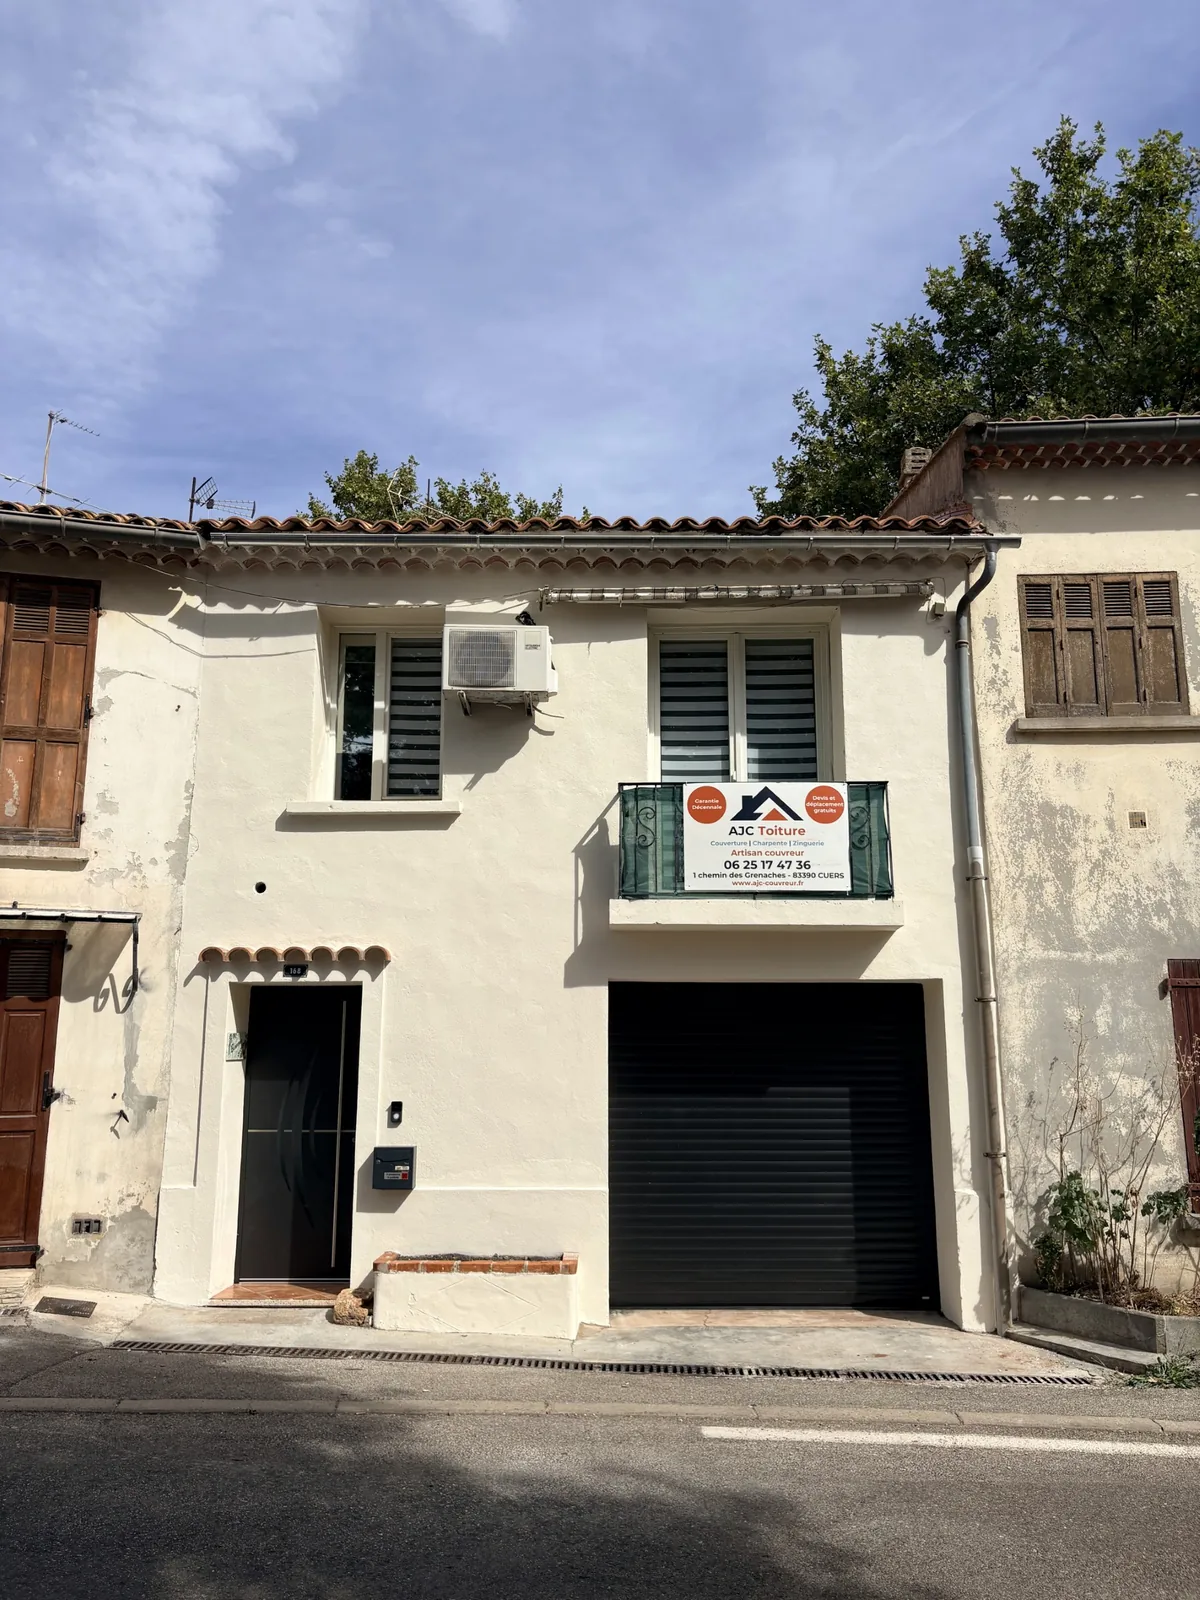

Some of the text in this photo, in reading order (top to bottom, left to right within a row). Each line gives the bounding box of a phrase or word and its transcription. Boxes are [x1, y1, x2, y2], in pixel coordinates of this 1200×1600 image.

[728, 825, 806, 836] AJC Toiture
[752, 840, 788, 848] Charpente
[731, 849, 763, 857] Artisan
[724, 860, 811, 870] 06 25 17 47 36
